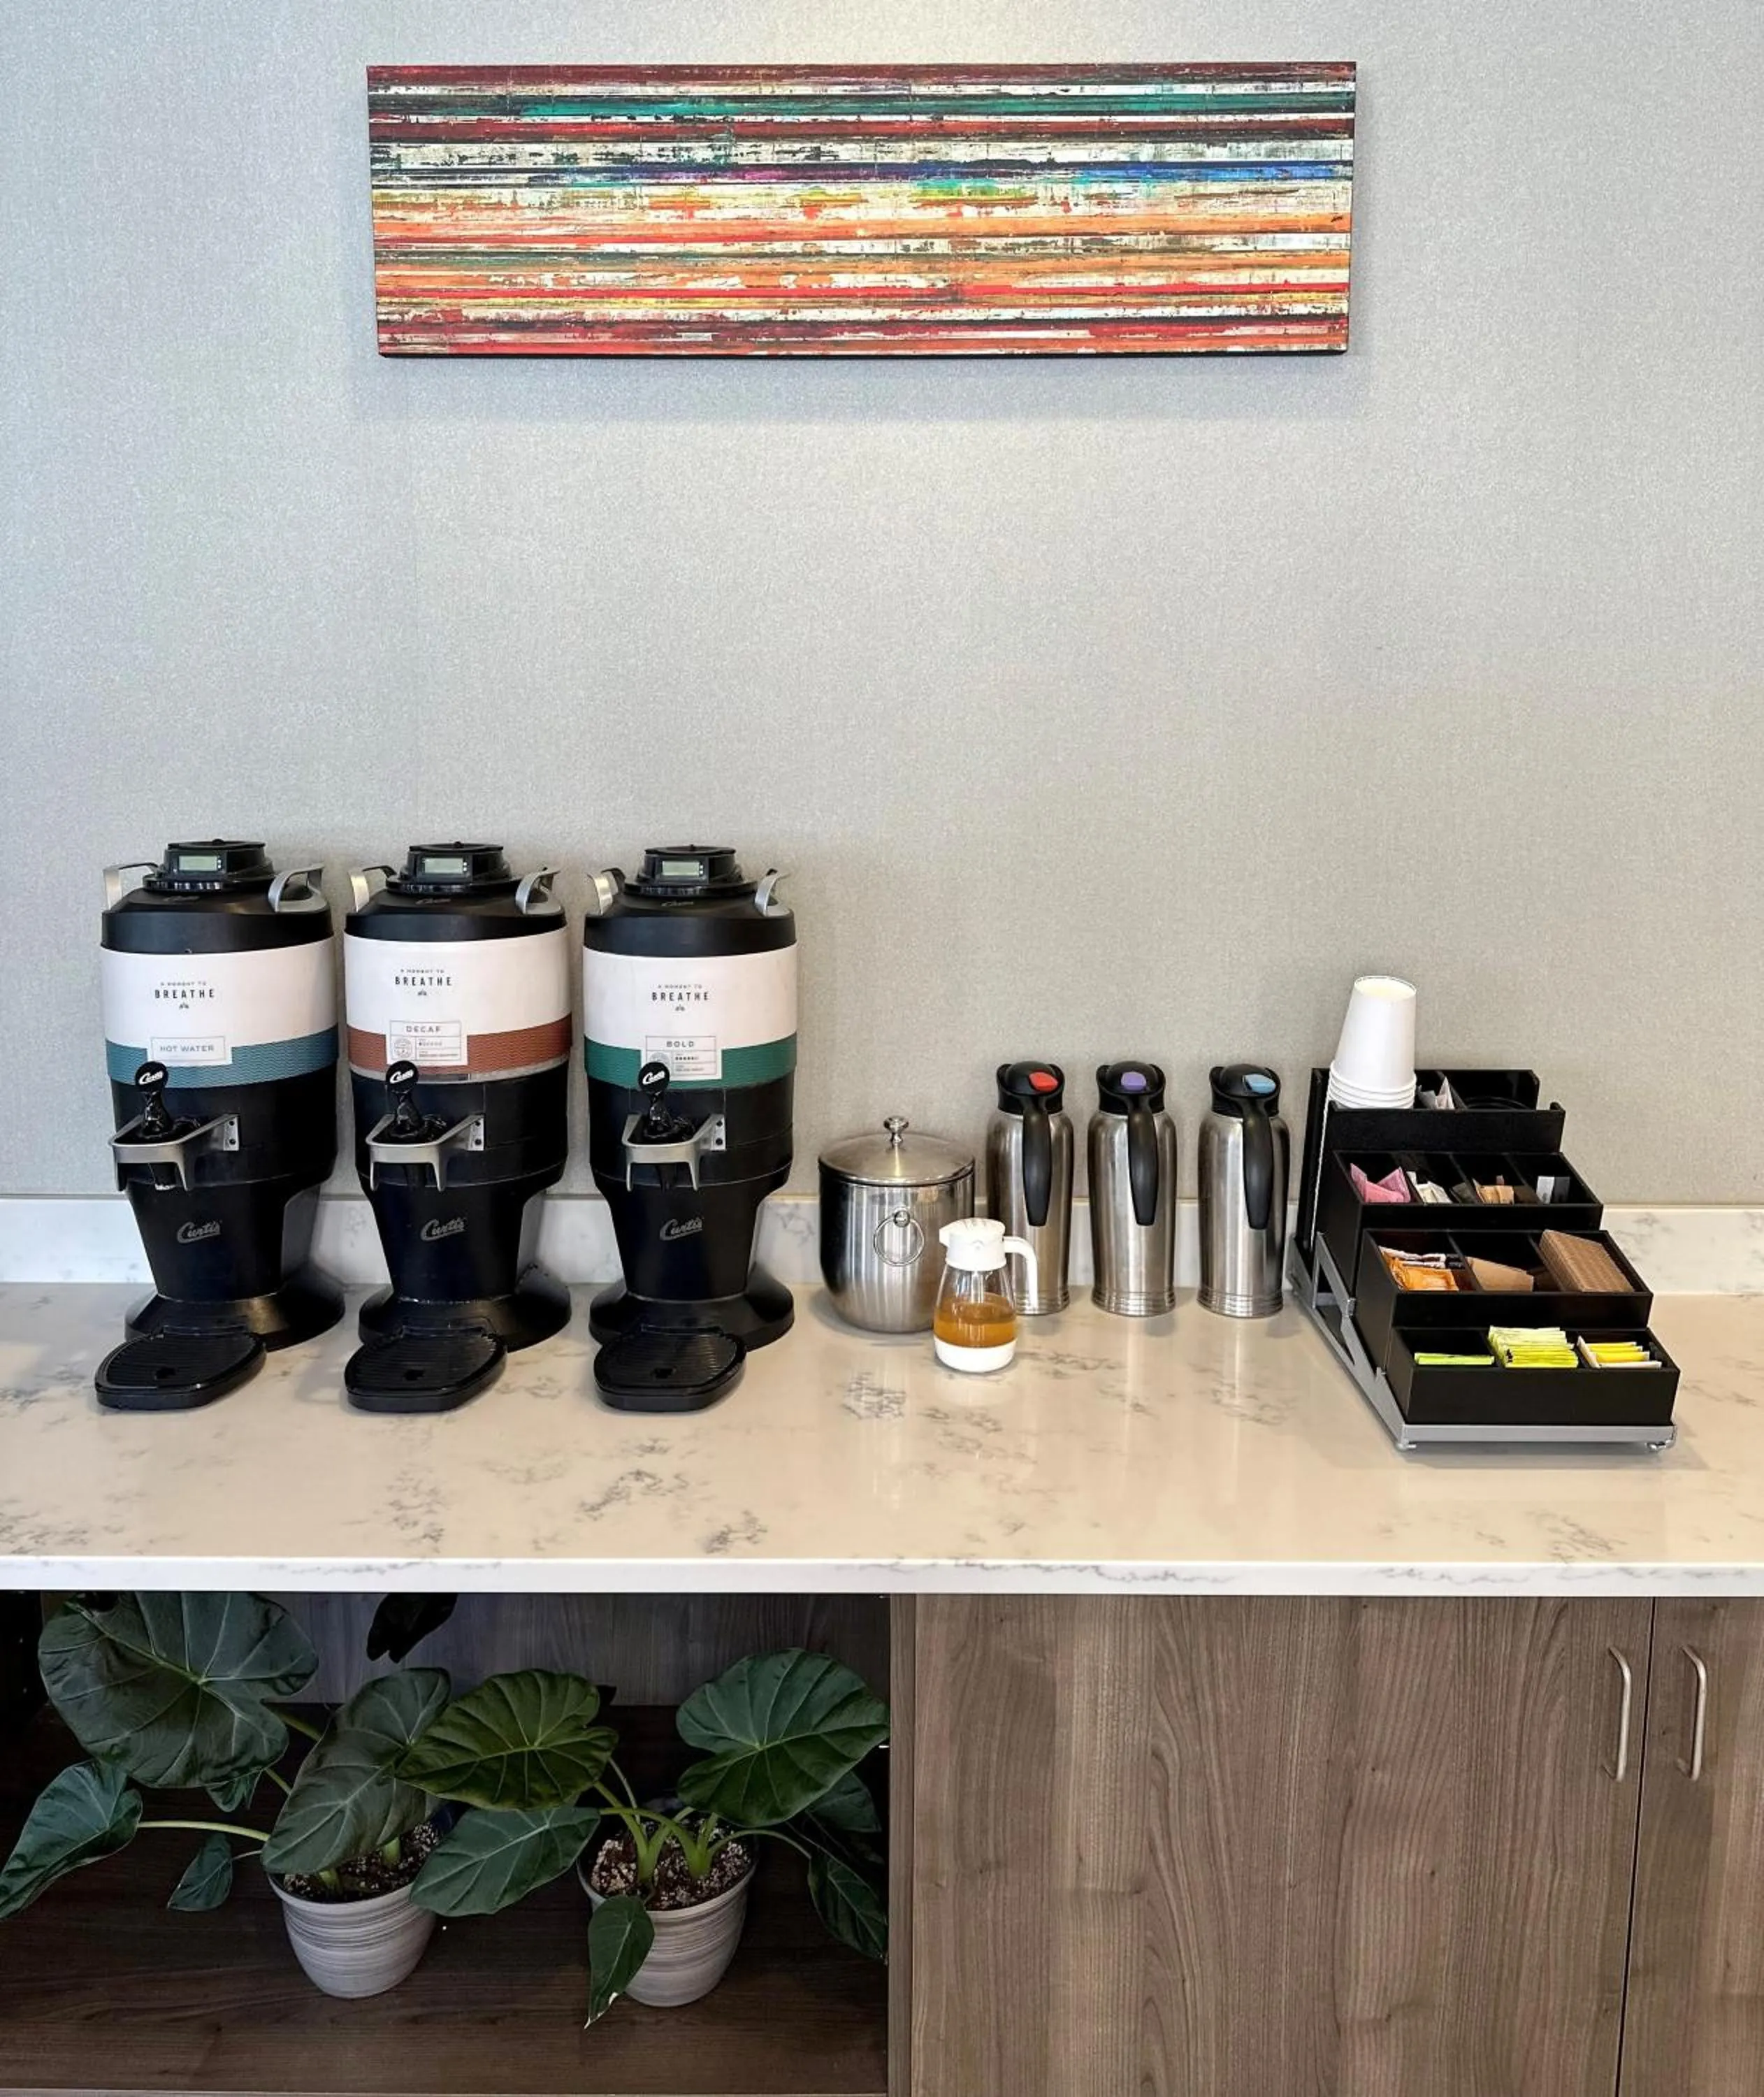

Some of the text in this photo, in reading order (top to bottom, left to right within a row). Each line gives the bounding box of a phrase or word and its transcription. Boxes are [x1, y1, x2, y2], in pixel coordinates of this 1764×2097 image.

[395, 976, 452, 986] BREATHE
[154, 988, 215, 999] BREATHE
[651, 991, 709, 1002] BREATHE
[177, 1221, 221, 1244] Curtis
